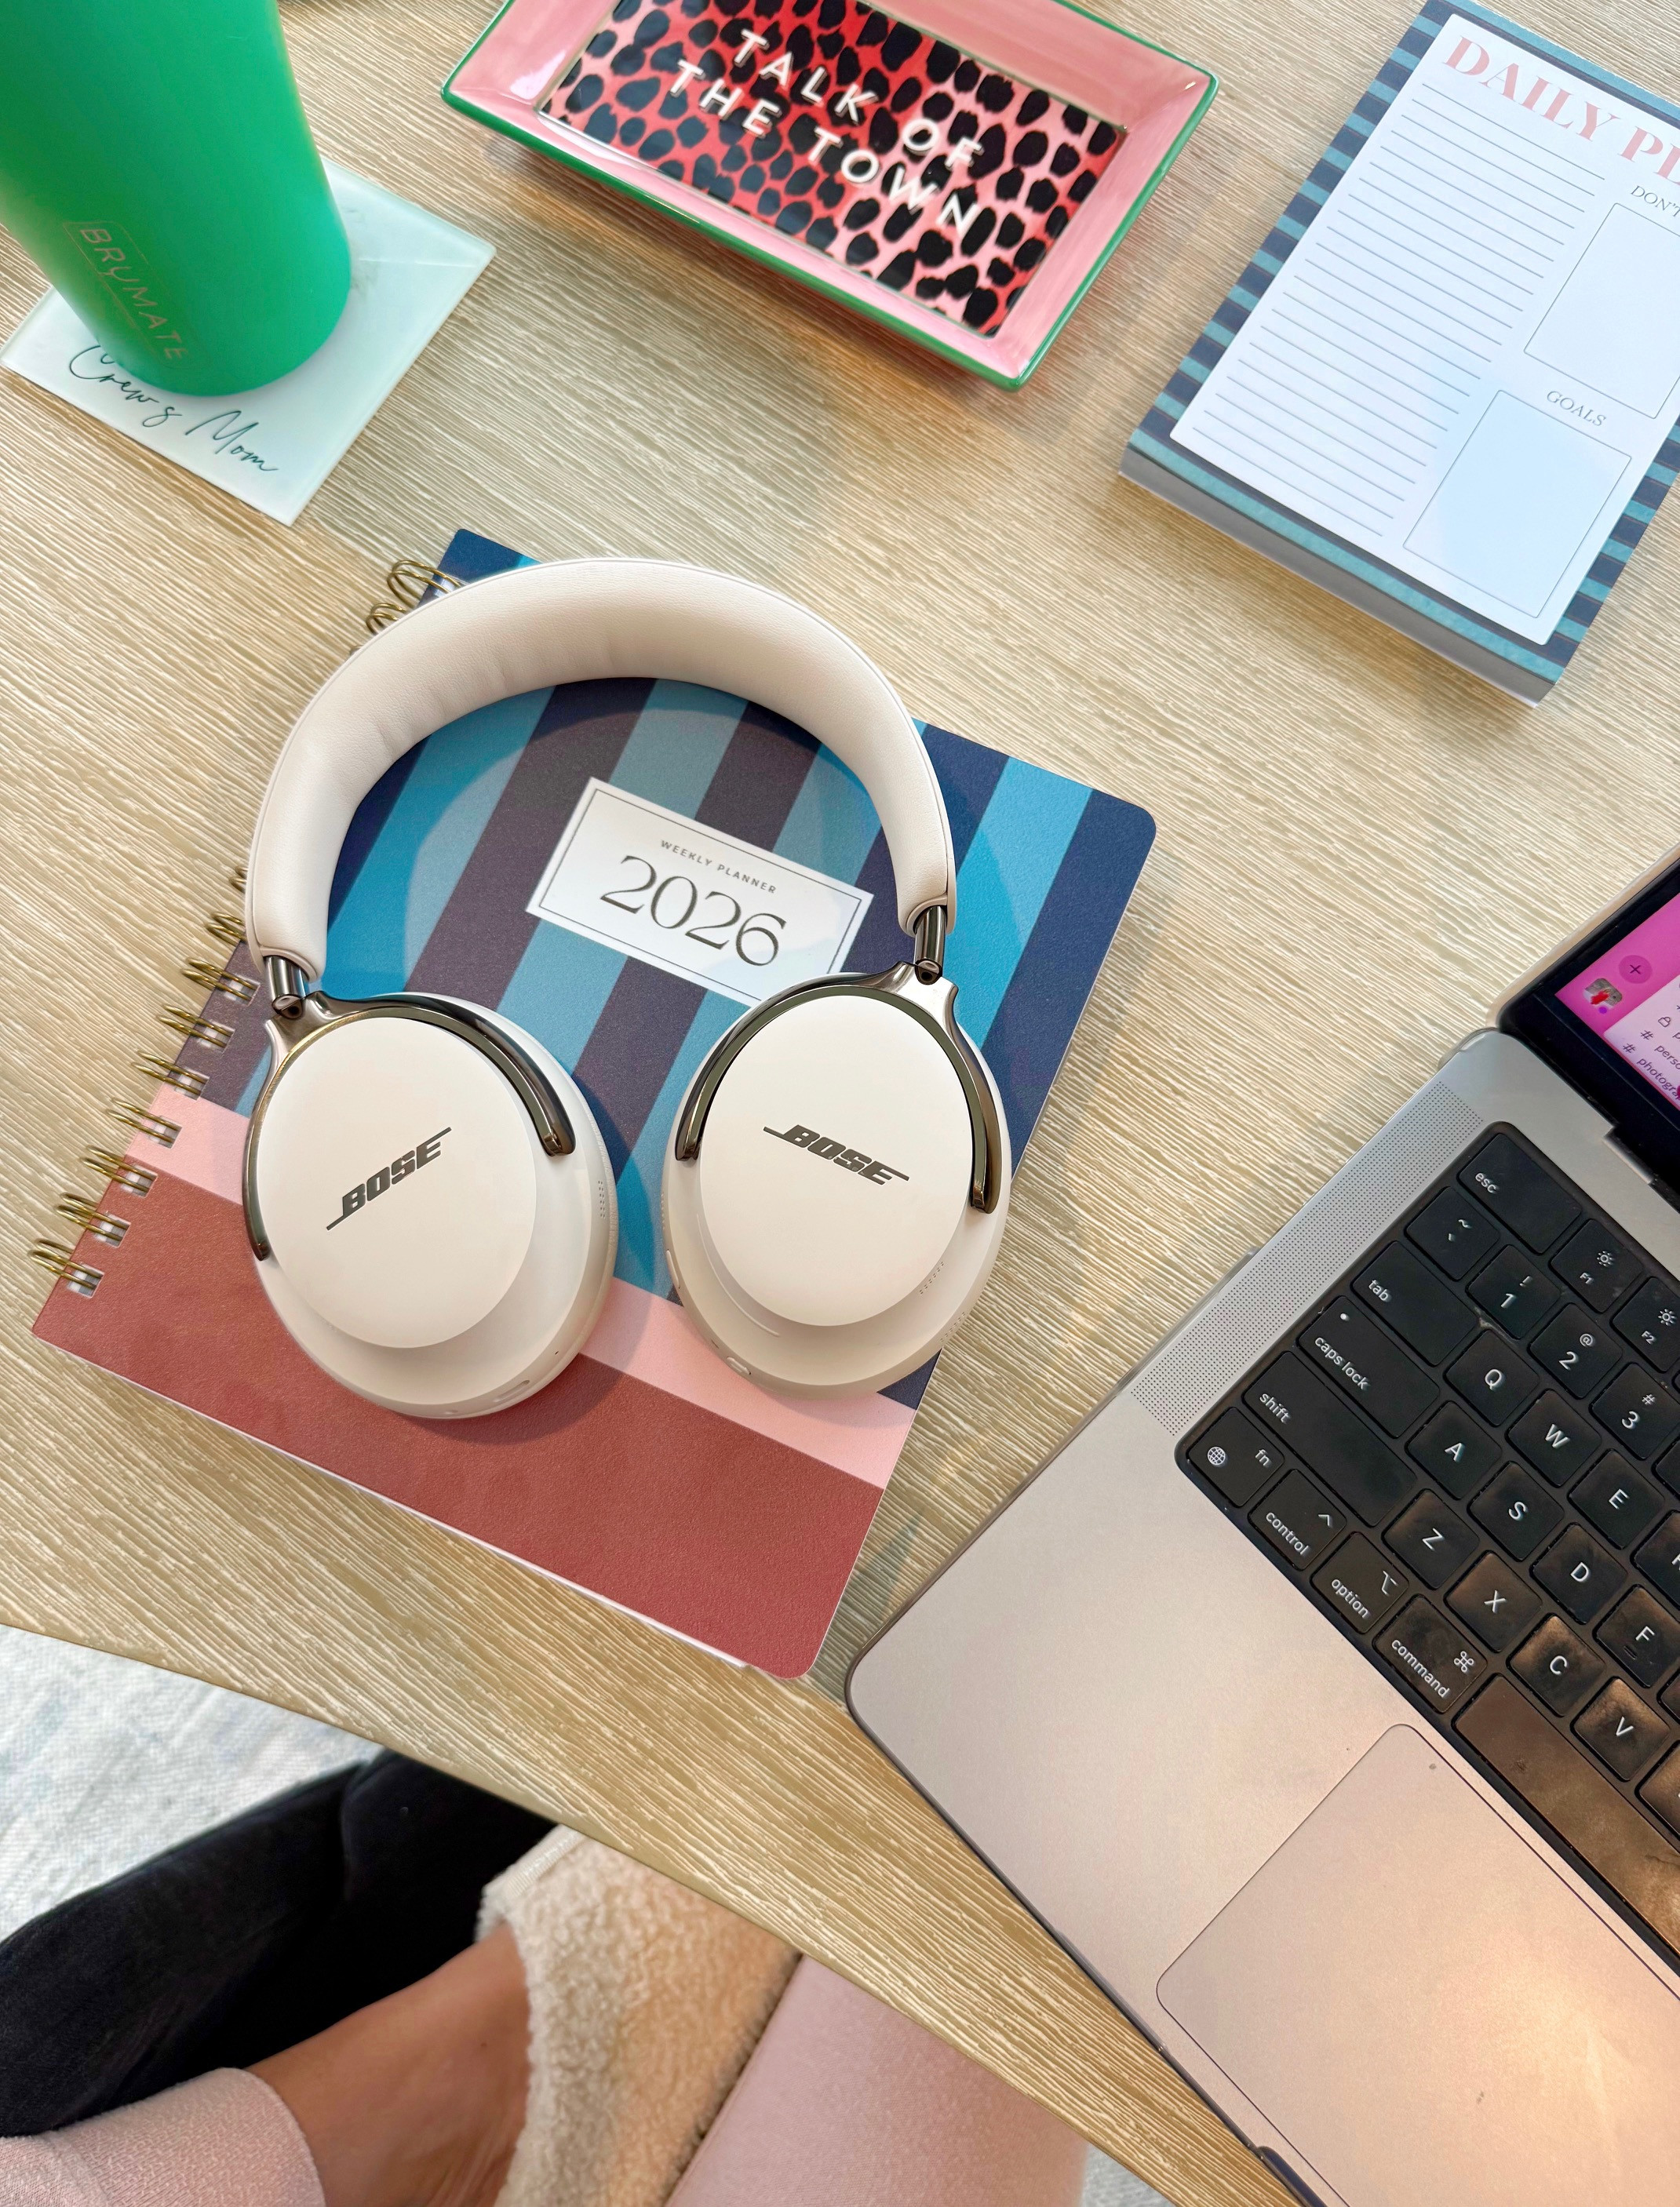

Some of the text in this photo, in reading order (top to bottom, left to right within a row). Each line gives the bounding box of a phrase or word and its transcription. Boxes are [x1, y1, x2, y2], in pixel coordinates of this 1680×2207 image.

[733, 28, 984, 170] TALK OF
[1441, 35, 1621, 142] DAILY
[669, 59, 978, 235] THE TOWN
[1547, 391, 1606, 426] GOALS
[184, 410, 279, 472] Mom
[661, 839, 777, 894] WEEKLY PLANNER
[600, 854, 787, 967] 2026
[763, 1124, 909, 1185] BOSE
[326, 1127, 452, 1231] BOSE
[1475, 1173, 1497, 1193] esc
[1580, 1272, 1594, 1285] F1
[1368, 1279, 1390, 1302] tab
[1500, 1293, 1516, 1309] 1
[1642, 1331, 1656, 1345] F2
[1315, 1337, 1368, 1389] caps lock
[1558, 1351, 1579, 1371] 2
[1485, 1368, 1505, 1391] Q
[1259, 1393, 1291, 1424] shift
[1621, 1411, 1640, 1429] 3
[1544, 1424, 1569, 1450] W
[1255, 1449, 1271, 1467] fn
[1445, 1442, 1465, 1462] A
[1609, 1489, 1630, 1510] E
[1508, 1502, 1529, 1521] S
[1266, 1512, 1310, 1557] control
[1423, 1528, 1445, 1551] Z
[1570, 1562, 1590, 1583] D
[1331, 1579, 1370, 1619] option
[1485, 1590, 1506, 1613] X
[1635, 1626, 1655, 1643] F
[1391, 1639, 1451, 1699] command
[1549, 1655, 1568, 1676] C
[1615, 1717, 1634, 1737] V
